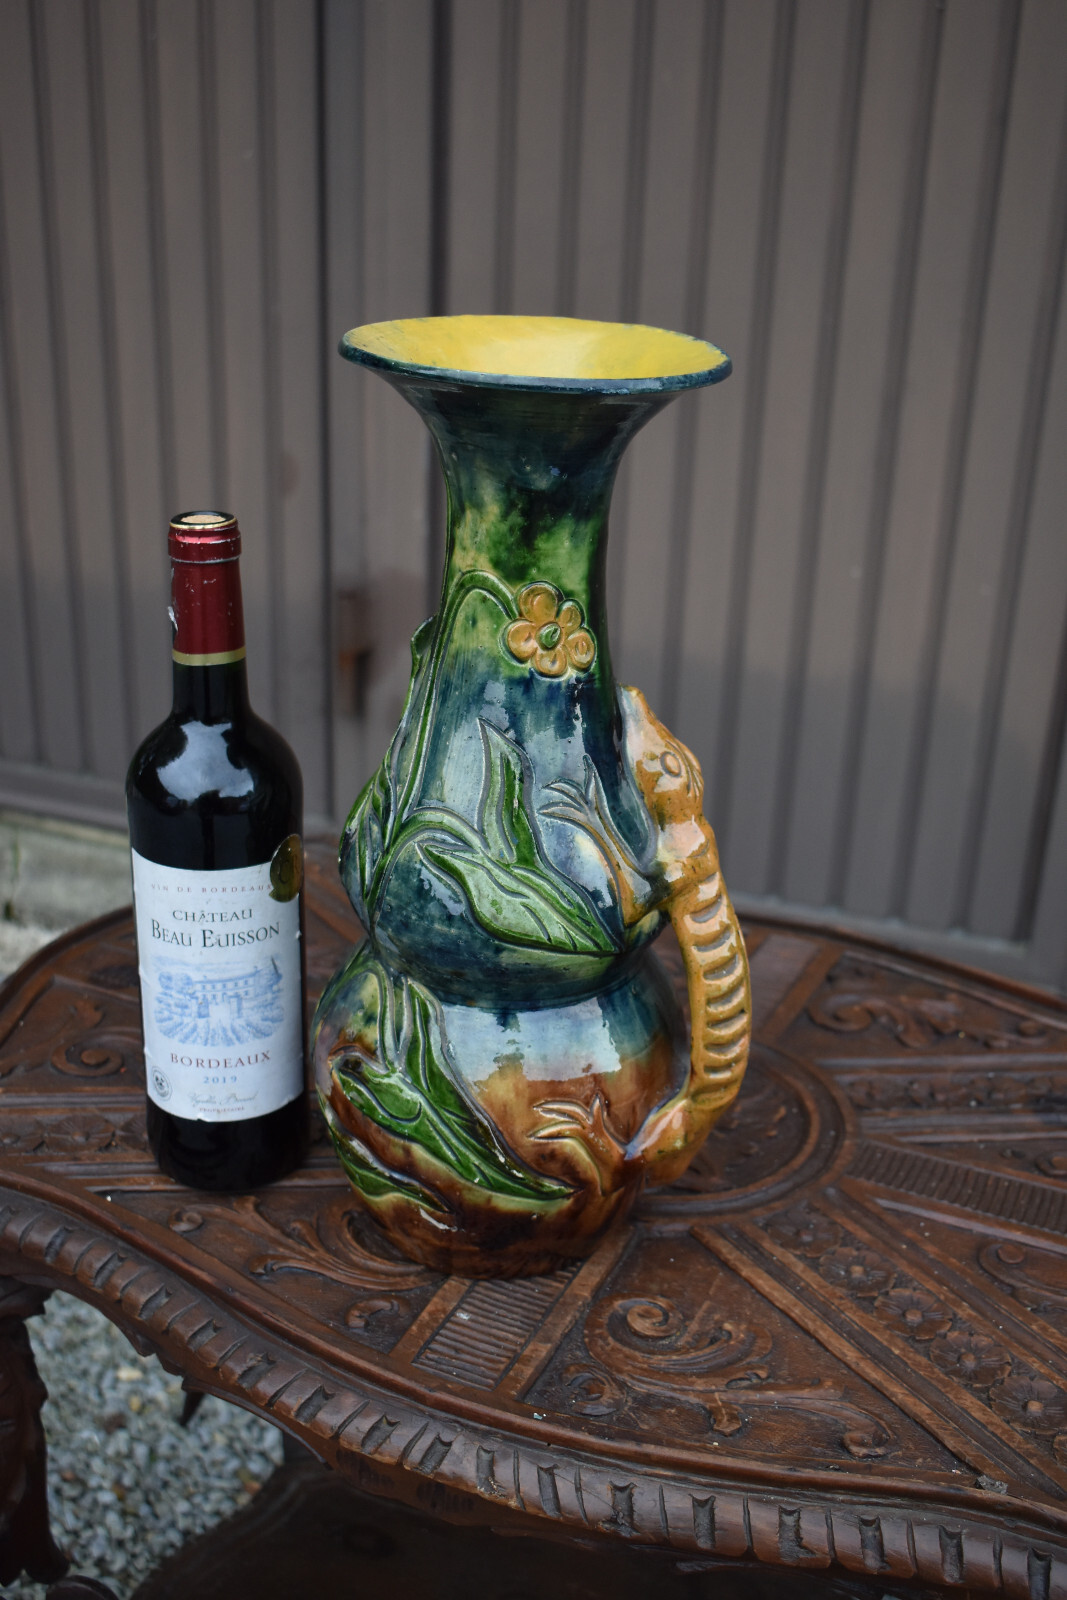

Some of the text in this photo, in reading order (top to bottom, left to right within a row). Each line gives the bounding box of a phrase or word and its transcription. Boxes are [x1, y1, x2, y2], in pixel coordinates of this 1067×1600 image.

[151, 918, 193, 947] BEAU
[170, 1050, 271, 1069] BORDEAUX
[203, 1076, 238, 1084] 2019
